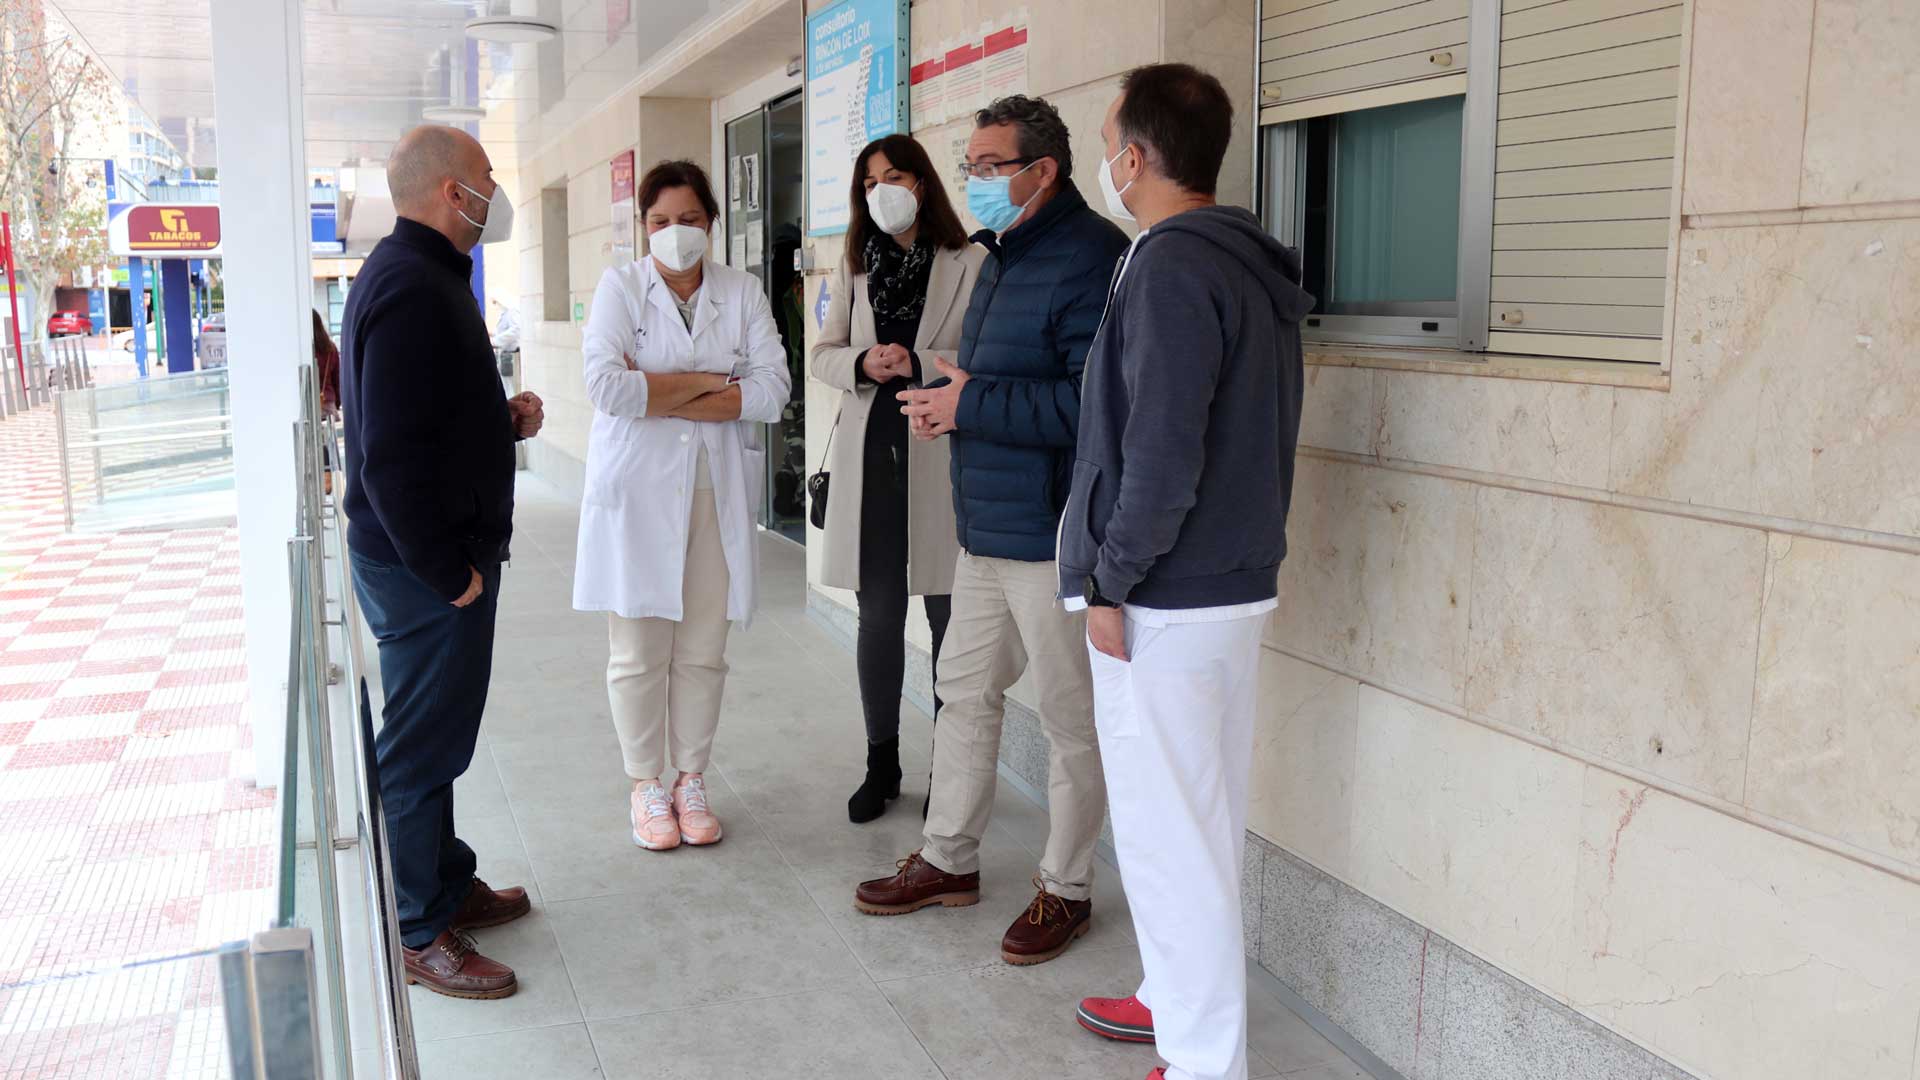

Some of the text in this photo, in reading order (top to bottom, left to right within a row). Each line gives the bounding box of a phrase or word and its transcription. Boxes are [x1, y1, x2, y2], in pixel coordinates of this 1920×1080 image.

[815, 6, 856, 41] consultorio
[842, 28, 852, 50] DE
[149, 231, 201, 241] TABACOS
